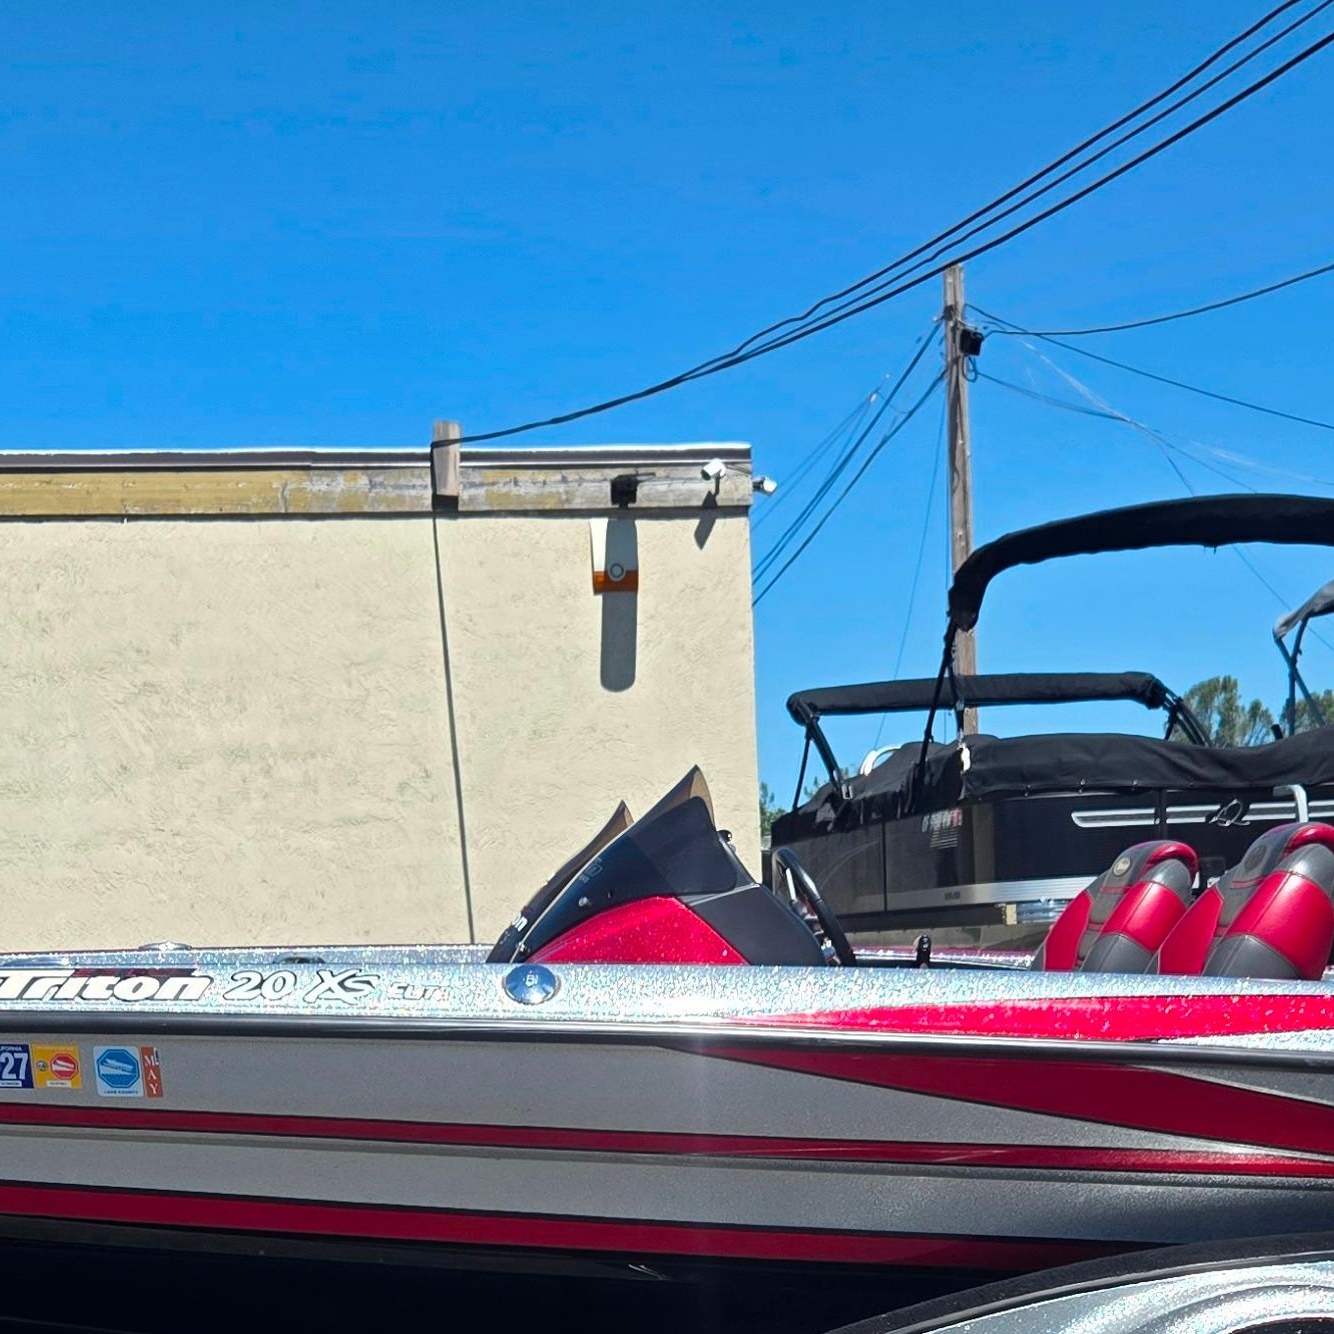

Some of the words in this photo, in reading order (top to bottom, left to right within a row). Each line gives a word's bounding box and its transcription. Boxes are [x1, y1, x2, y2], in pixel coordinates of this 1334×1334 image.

[223, 970, 300, 1000] 20
[303, 969, 382, 1004] XS
[0, 1052, 29, 1080] 27
